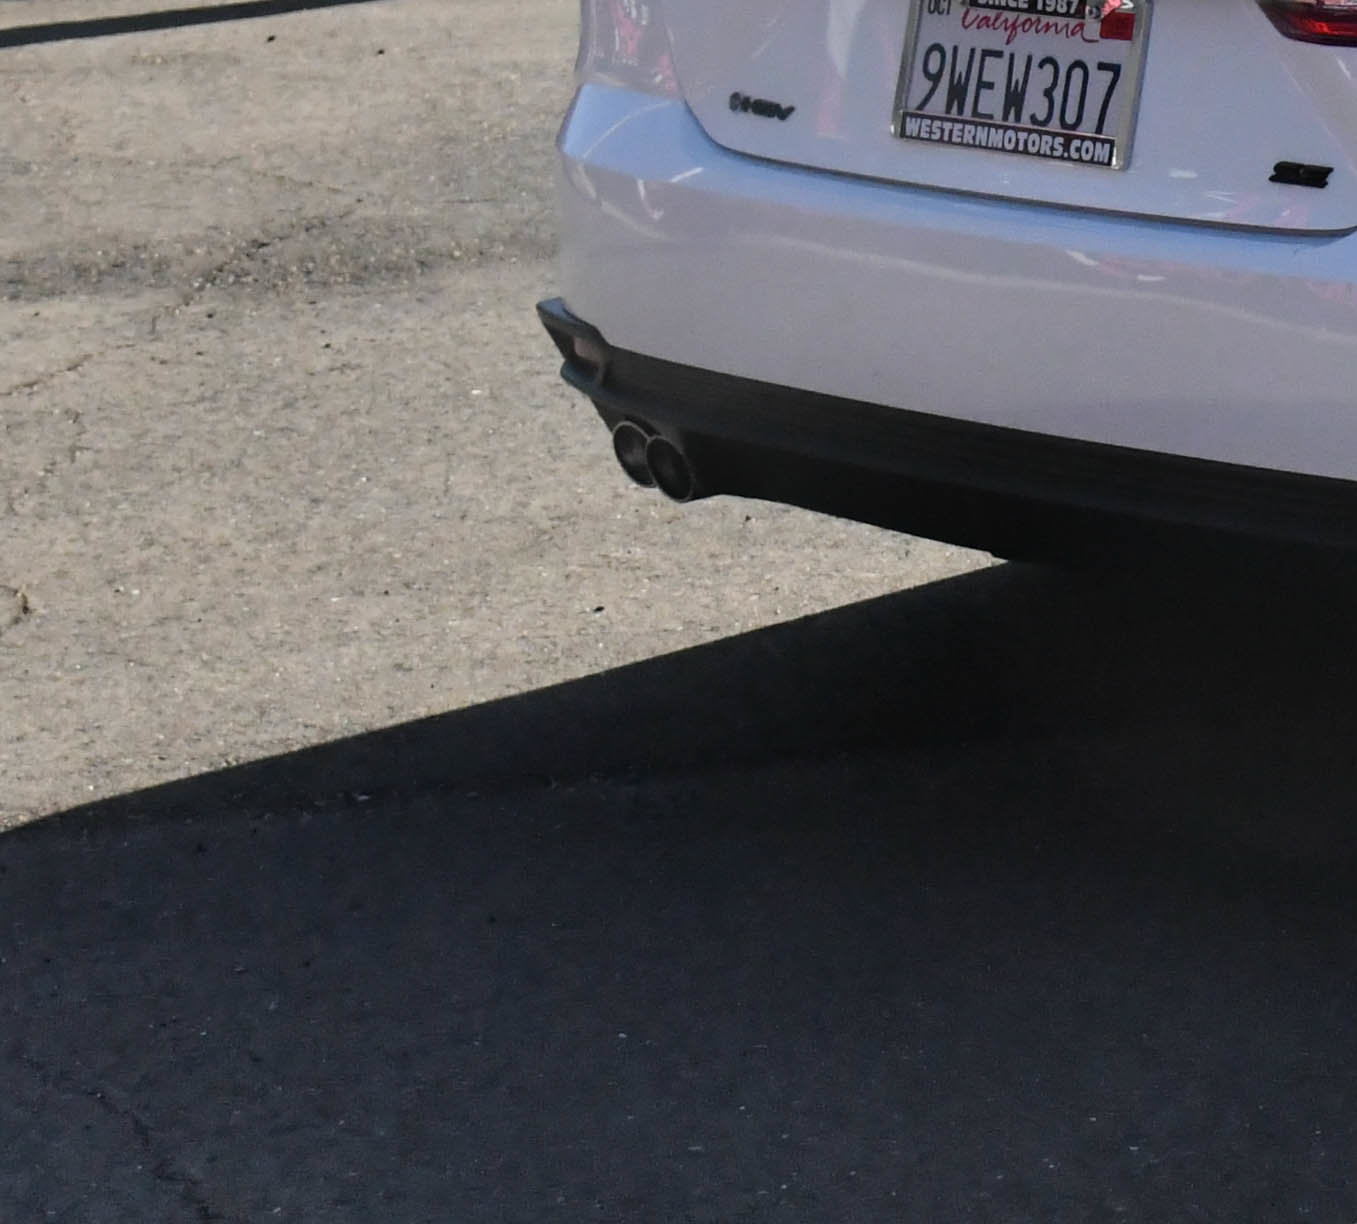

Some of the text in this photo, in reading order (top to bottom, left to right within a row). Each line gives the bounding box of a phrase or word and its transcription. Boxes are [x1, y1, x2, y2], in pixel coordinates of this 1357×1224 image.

[961, 8, 1101, 46] California
[915, 42, 1123, 135] 9WEW307
[904, 116, 1112, 164] WESTERNMOTORS.COM
